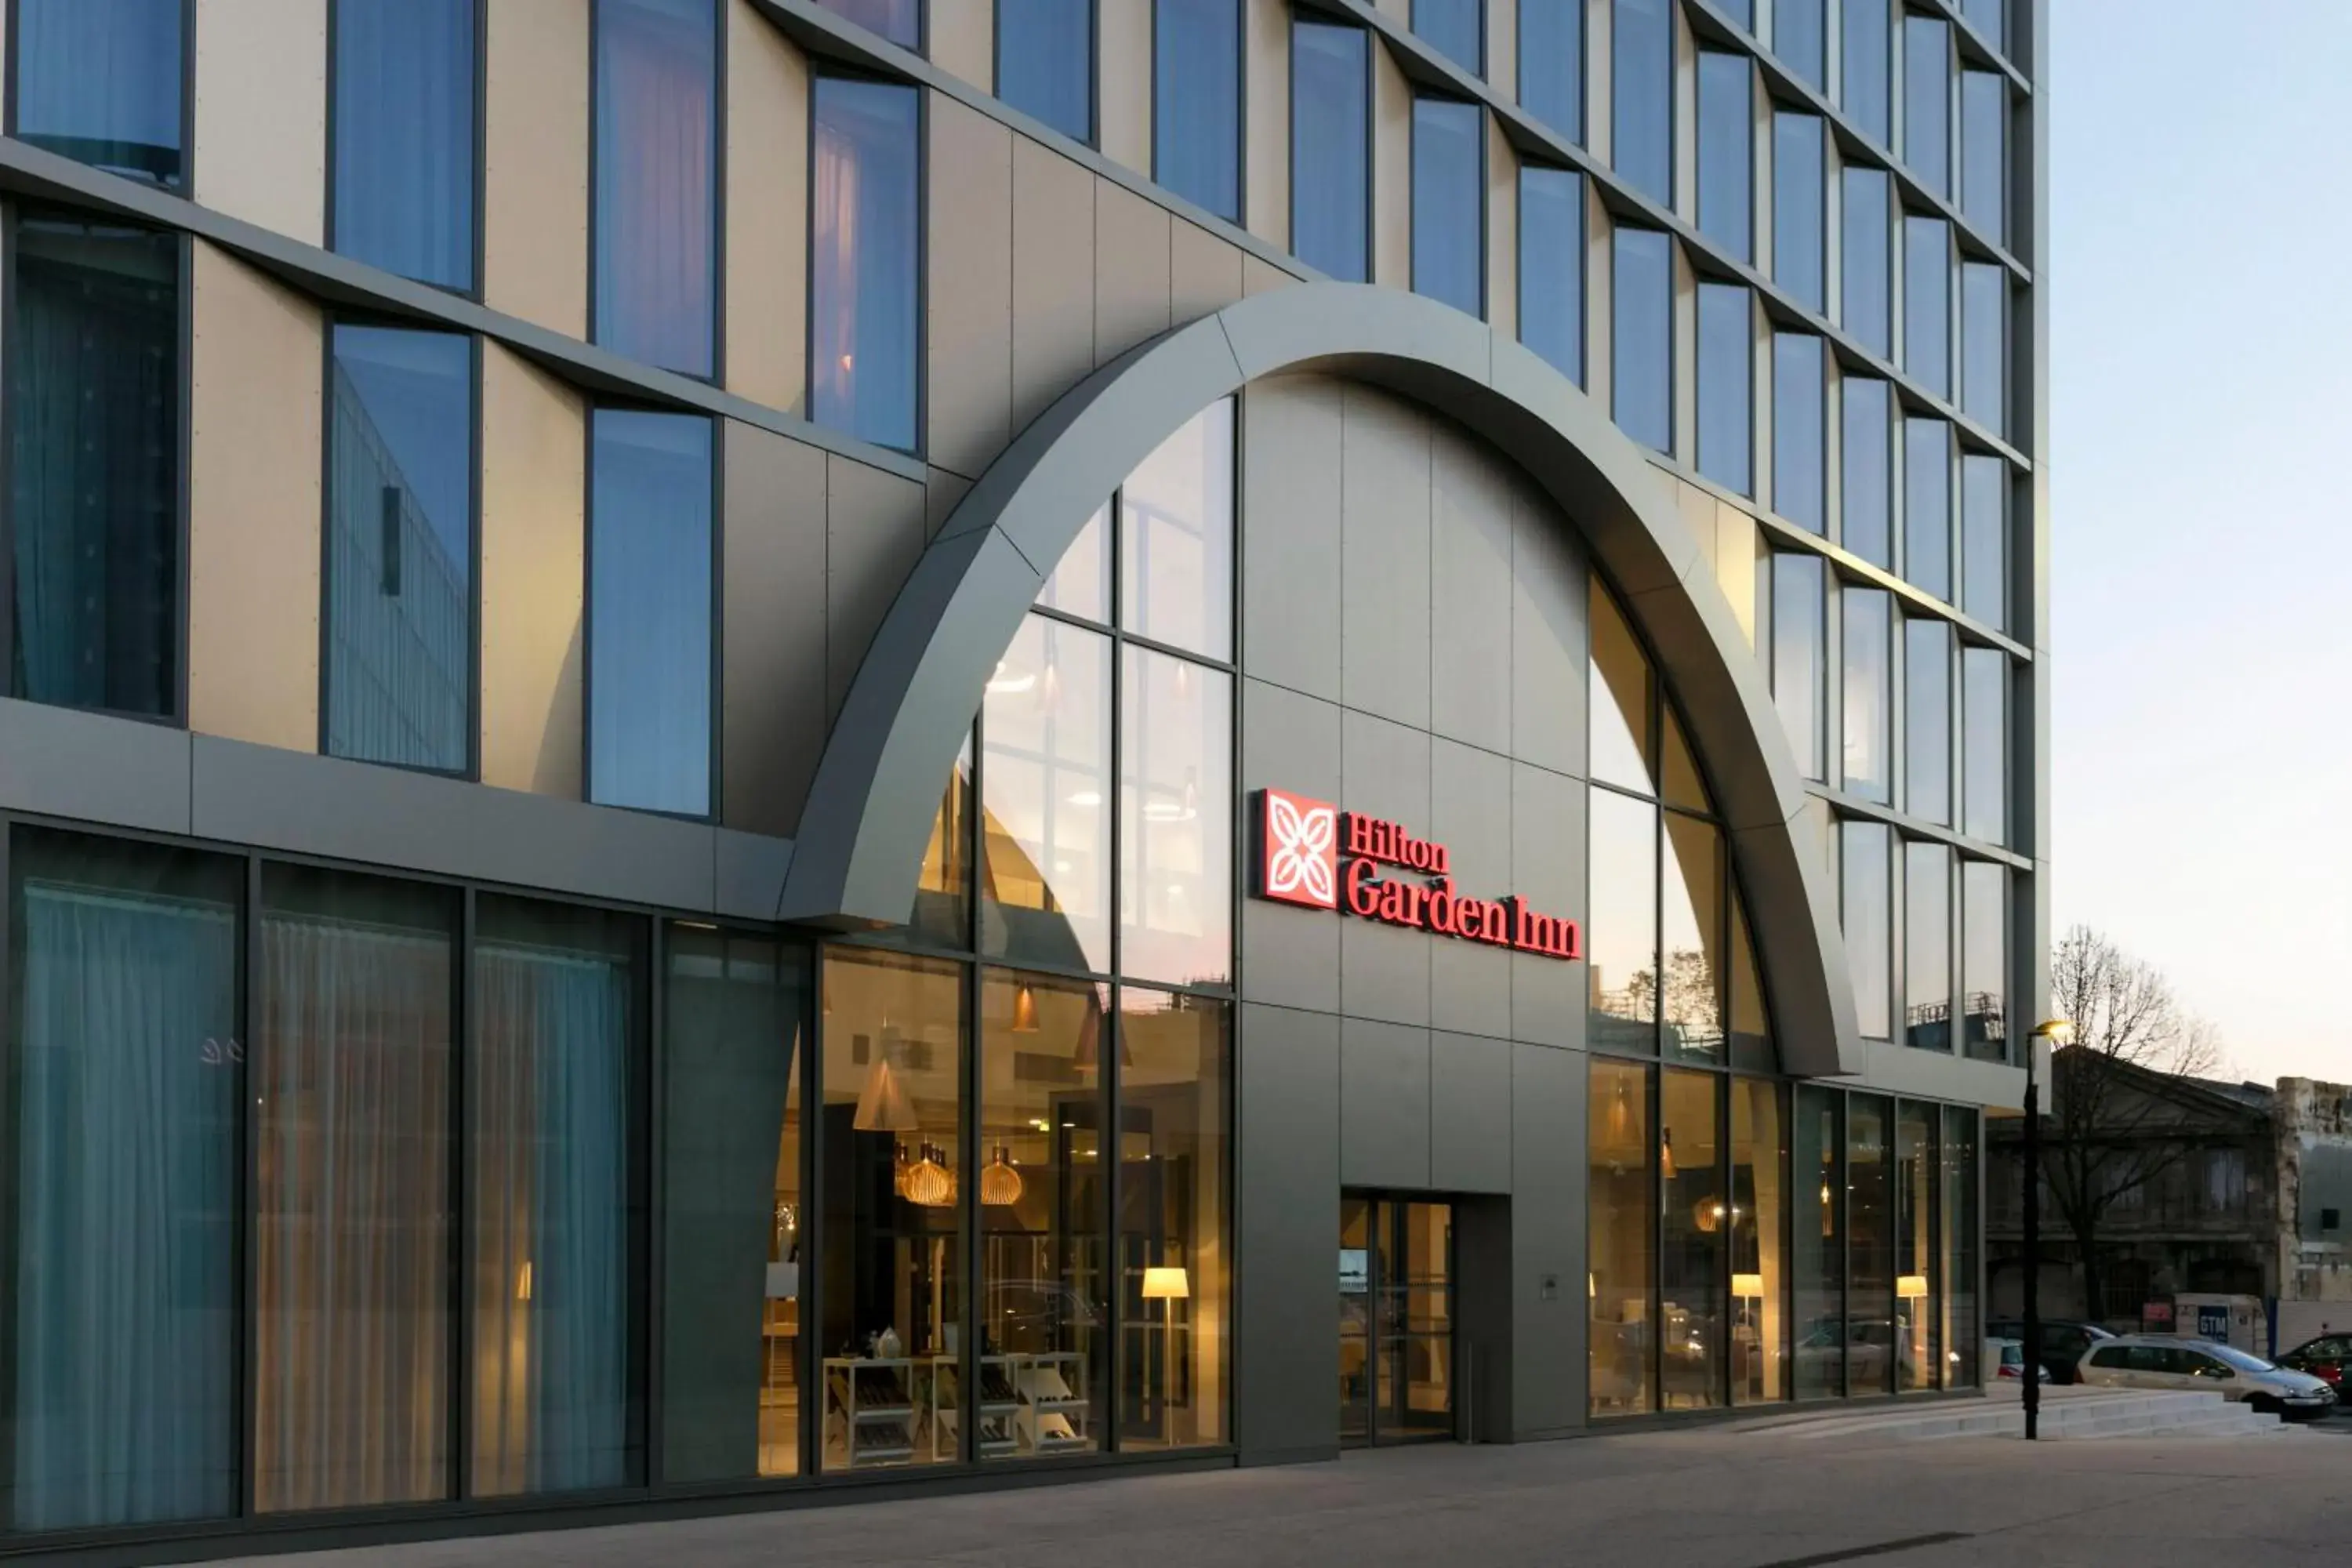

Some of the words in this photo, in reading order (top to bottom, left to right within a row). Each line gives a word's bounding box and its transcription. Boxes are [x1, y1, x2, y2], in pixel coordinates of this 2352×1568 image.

[1347, 811, 1450, 873] Hilton
[1347, 858, 1509, 945] Garden
[1514, 895, 1581, 959] Inn
[2200, 1316, 2226, 1333] GTM
